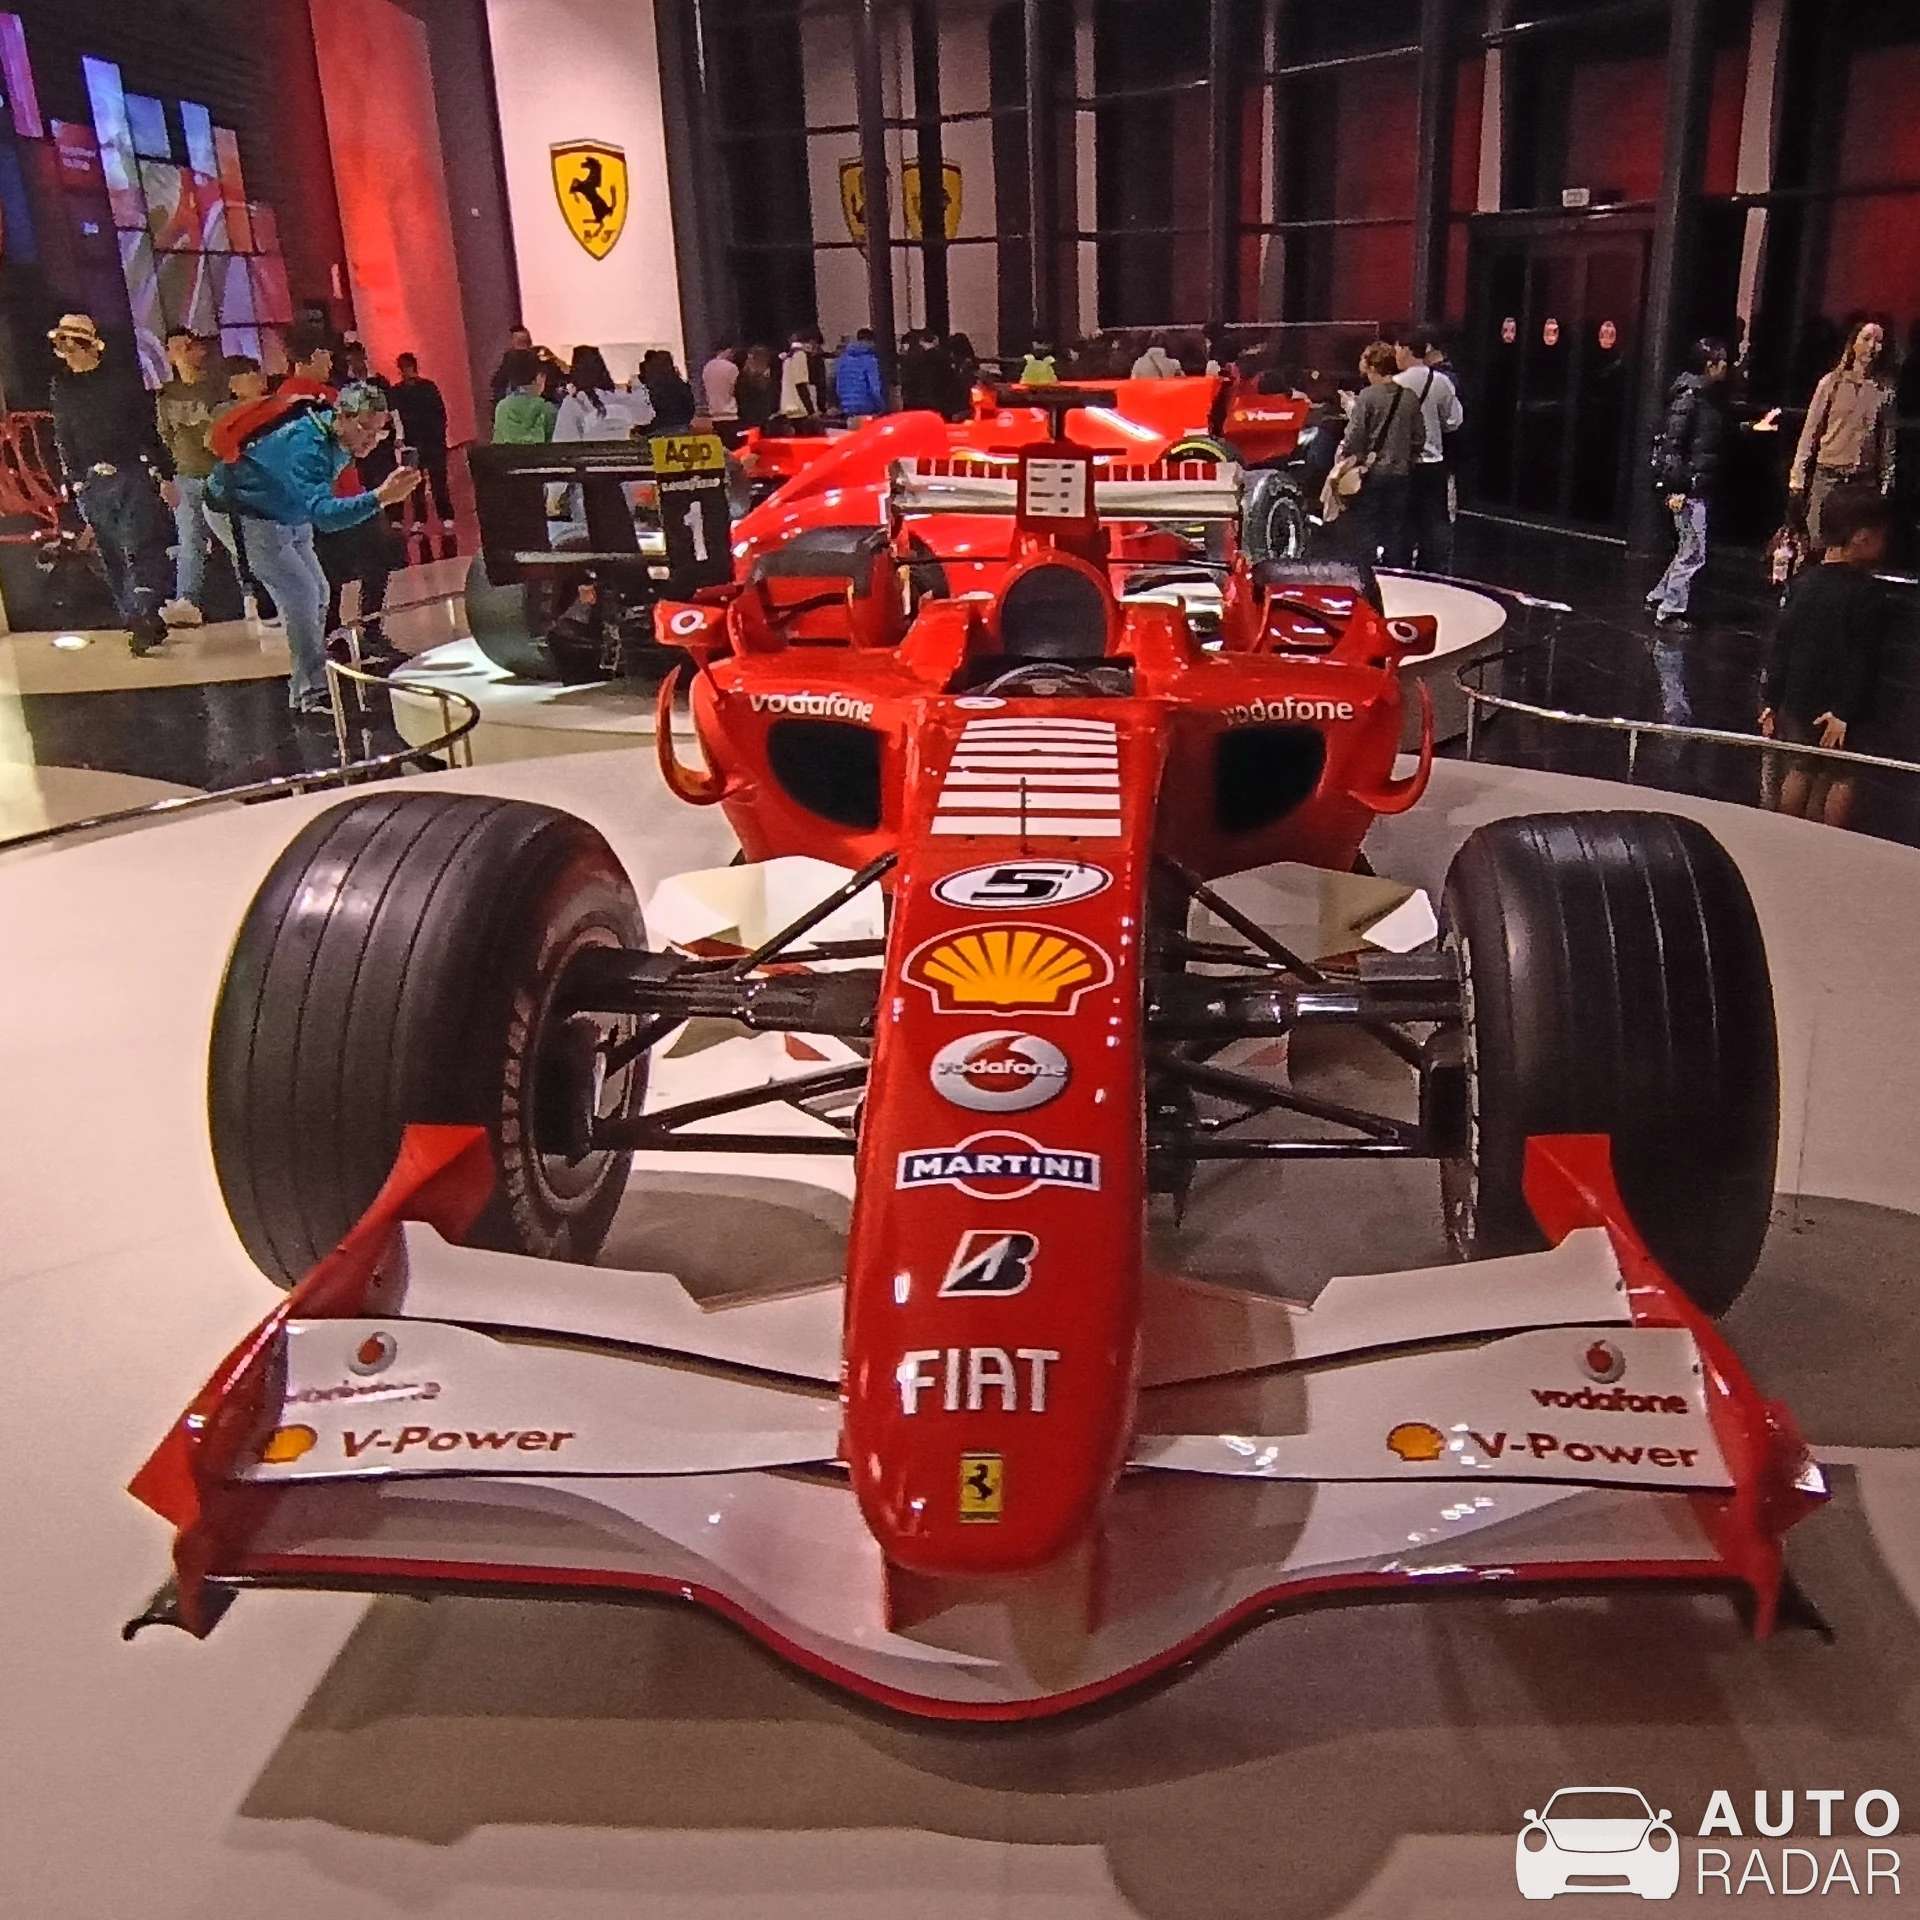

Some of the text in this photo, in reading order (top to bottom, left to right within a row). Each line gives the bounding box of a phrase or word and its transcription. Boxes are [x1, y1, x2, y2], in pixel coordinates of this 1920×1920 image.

[683, 501, 708, 561] 1
[749, 690, 874, 722] vodafone
[970, 868, 1073, 901] 5
[912, 1154, 1085, 1178] MARTINI
[896, 1348, 1061, 1415] FIAT
[1530, 1386, 1689, 1414] vodafone
[342, 1426, 577, 1457] V-Power
[1468, 1431, 1699, 1468] V-Power
